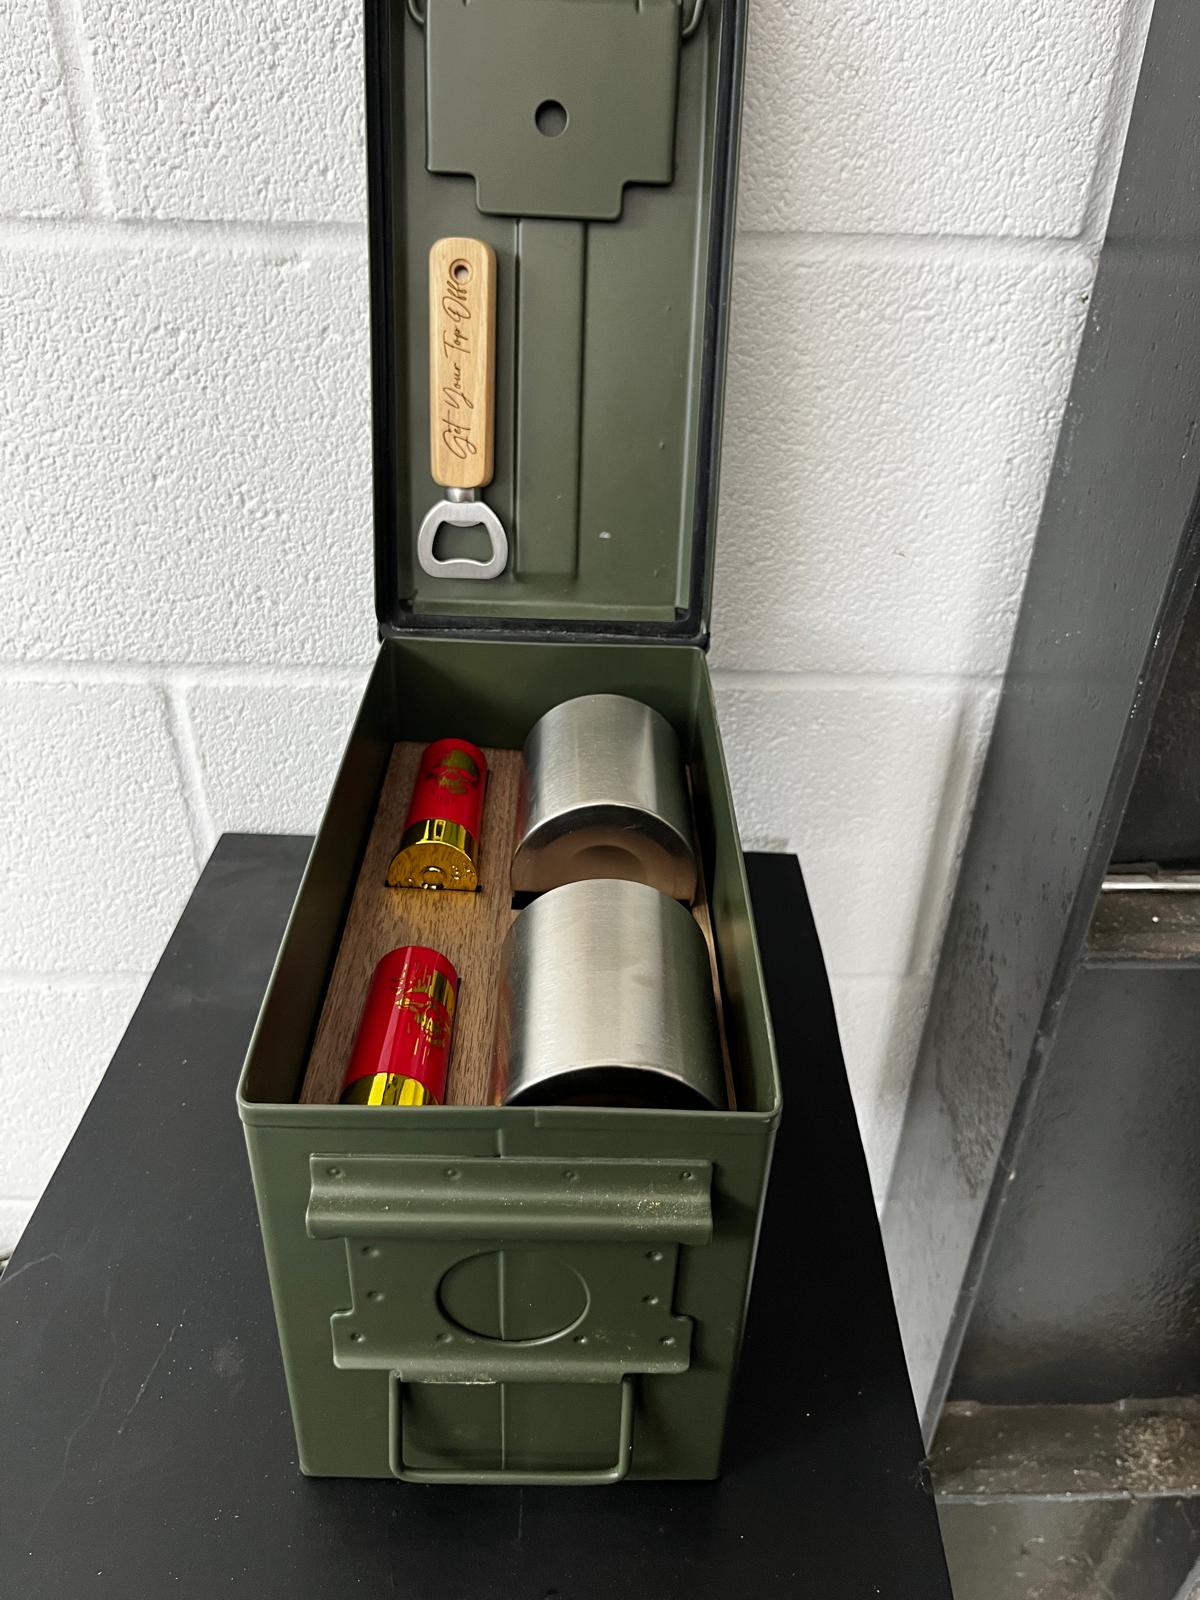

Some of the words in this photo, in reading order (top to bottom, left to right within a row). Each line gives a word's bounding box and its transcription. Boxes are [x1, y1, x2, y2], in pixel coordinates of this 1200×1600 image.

[442, 281, 472, 323] Off
[442, 326, 471, 358] Top
[442, 362, 474, 409] Your
[442, 410, 477, 460] Get
